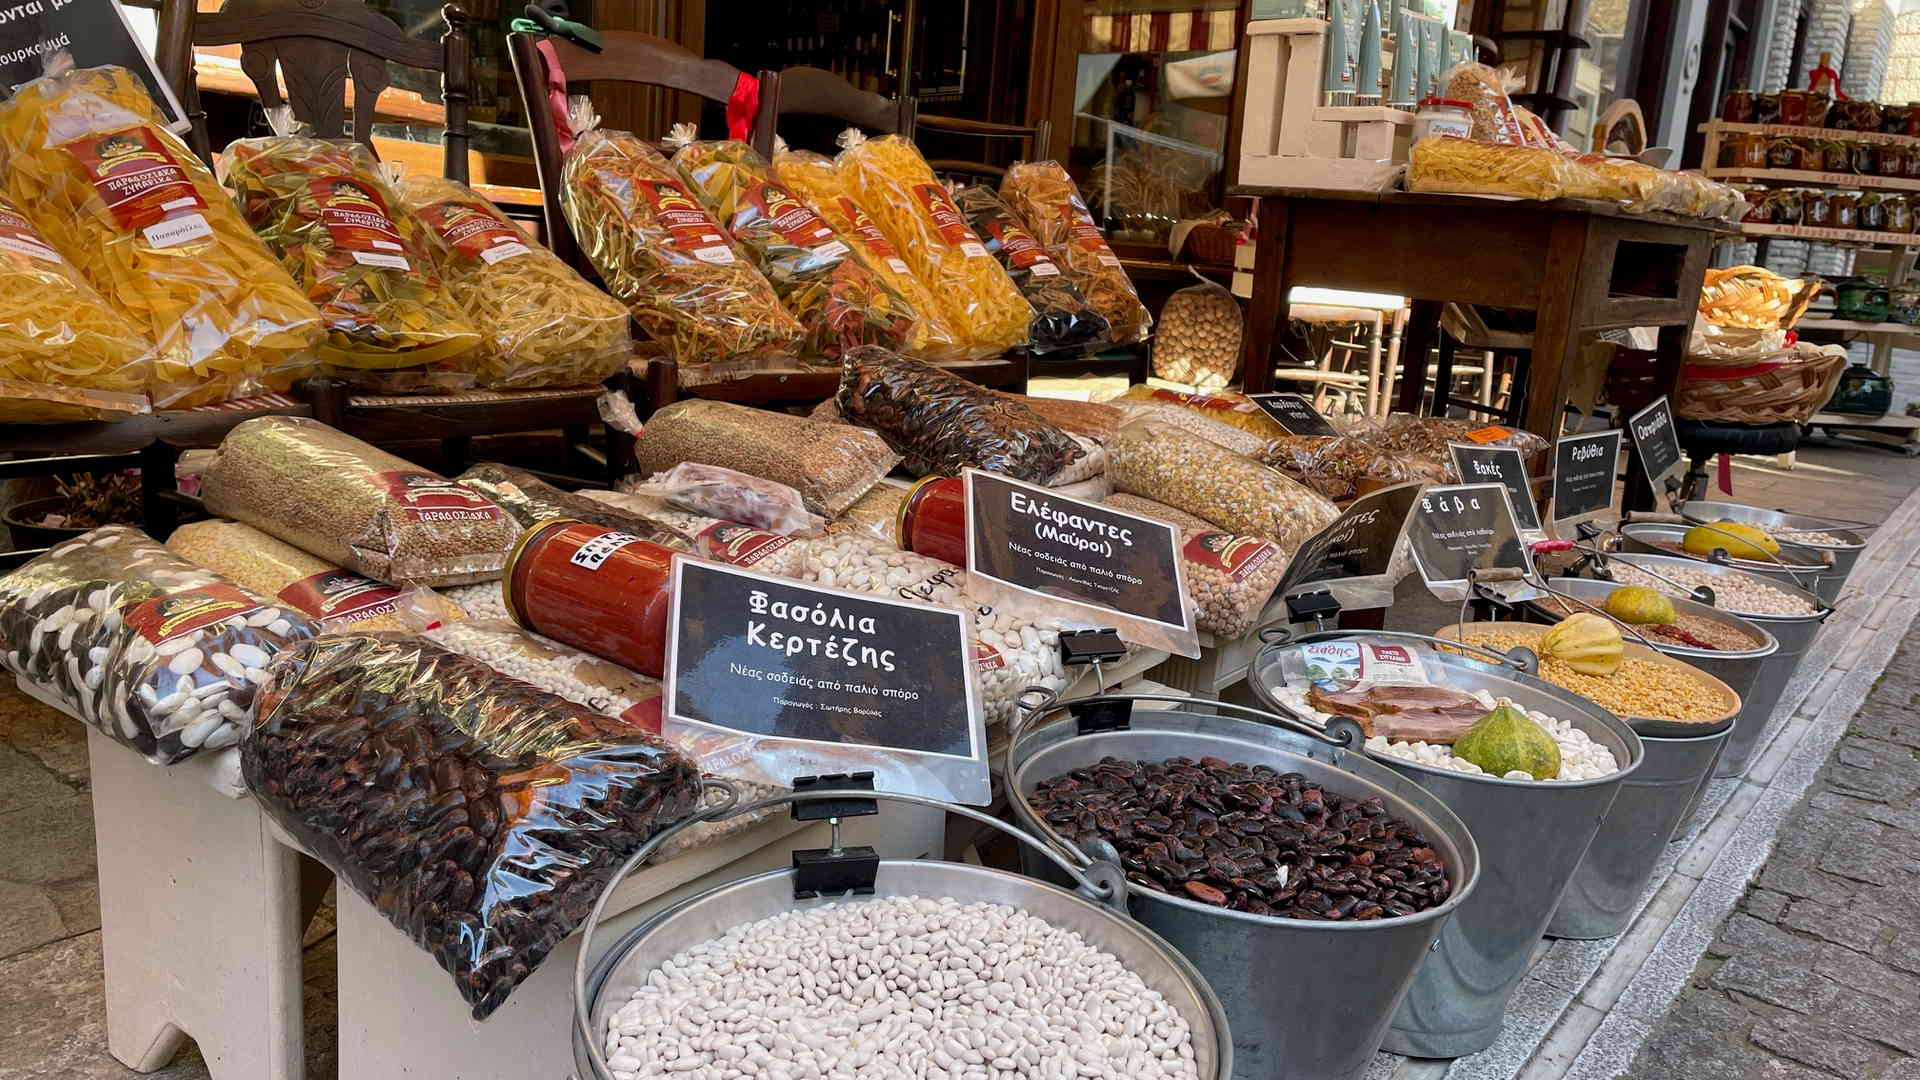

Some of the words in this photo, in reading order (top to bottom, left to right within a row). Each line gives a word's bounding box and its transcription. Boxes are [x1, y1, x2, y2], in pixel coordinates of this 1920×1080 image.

[1472, 459, 1503, 479] Φακές
[1010, 491, 1133, 547] Ελέφαντες
[1034, 521, 1113, 558] (Μαύροι)
[1008, 541, 1032, 557] Νέας
[1034, 550, 1068, 567] σοδειάς
[1070, 561, 1087, 571] από
[1089, 565, 1114, 578] παλιό
[1115, 572, 1143, 585] σπόρο
[748, 590, 877, 635] Φασόλια
[747, 620, 896, 672] Κερτέζης
[729, 661, 763, 681] Νέας
[766, 670, 814, 690] σοδειάς
[817, 679, 842, 692] από
[844, 682, 879, 696] παλιό
[882, 687, 920, 701] σπόρο
